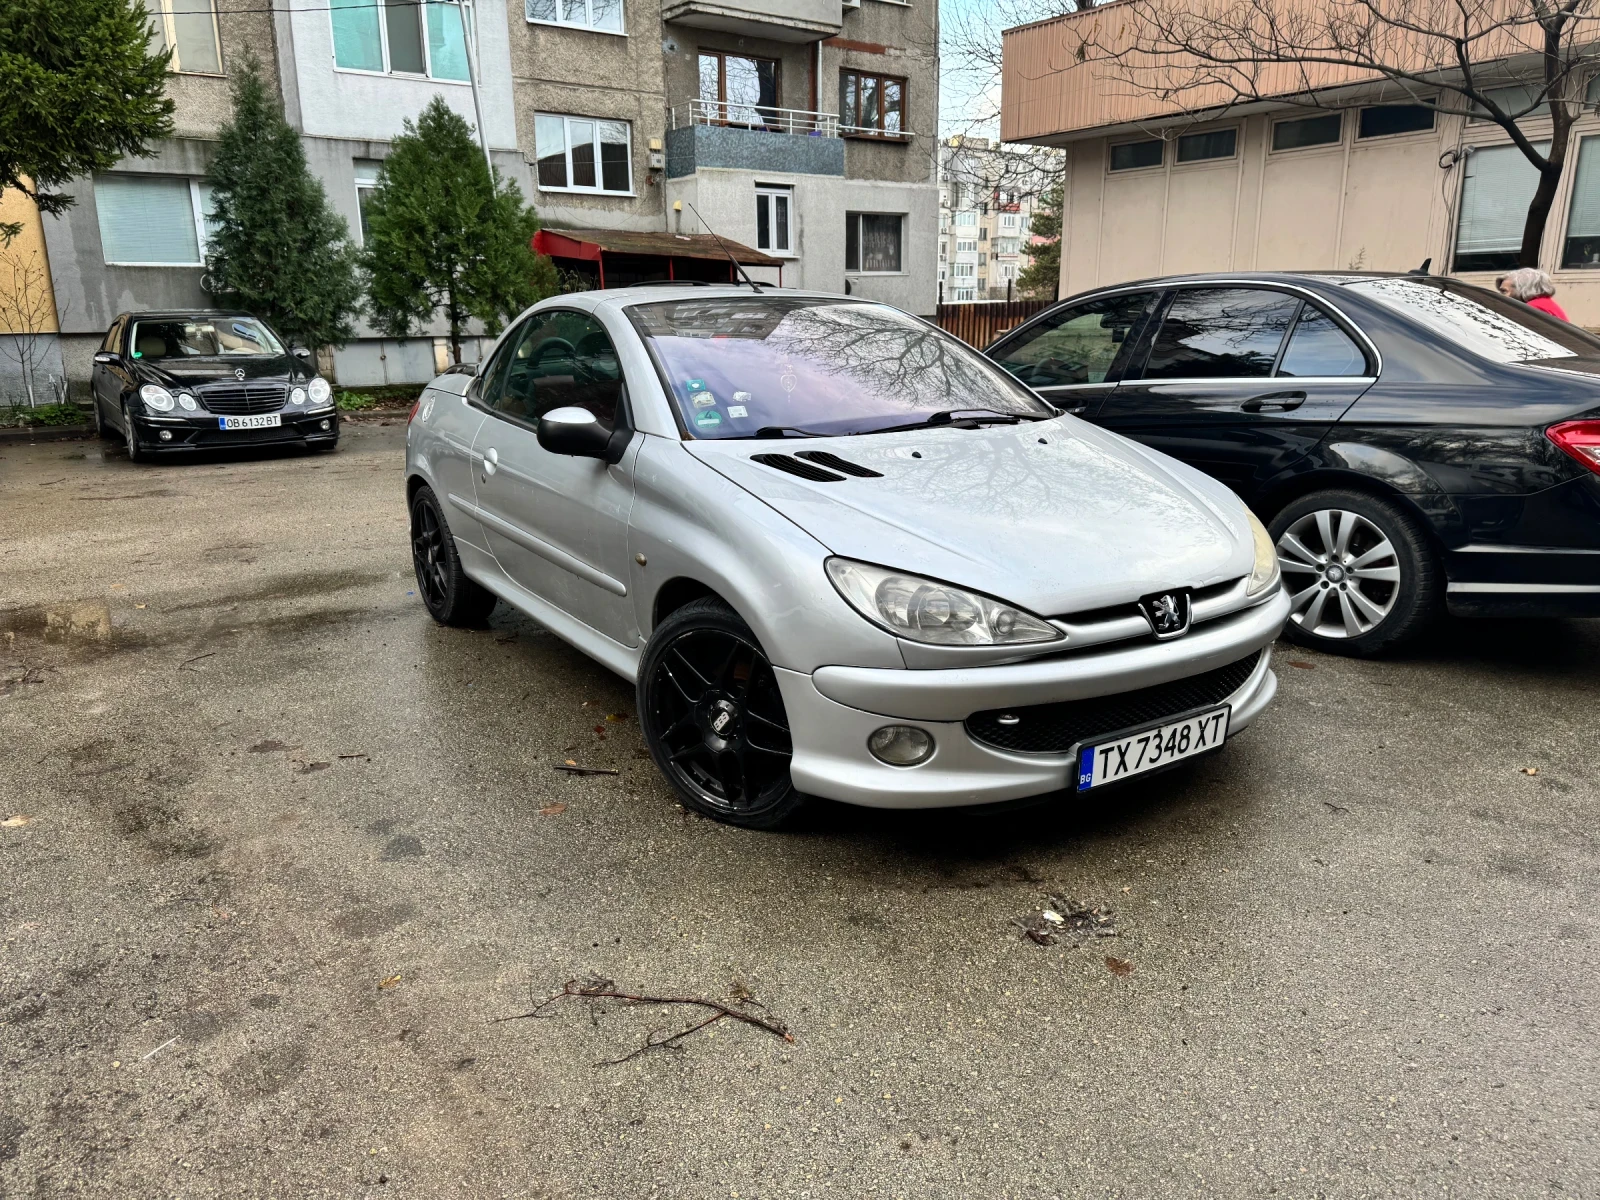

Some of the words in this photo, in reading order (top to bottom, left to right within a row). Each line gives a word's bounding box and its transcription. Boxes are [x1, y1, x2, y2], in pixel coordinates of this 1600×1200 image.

[242, 417, 265, 428] 6132
[266, 416, 278, 426] BT
[1099, 741, 1131, 779] TX
[1134, 724, 1191, 769] 7348
[1193, 712, 1225, 750] XT
[1080, 773, 1091, 784] BG
